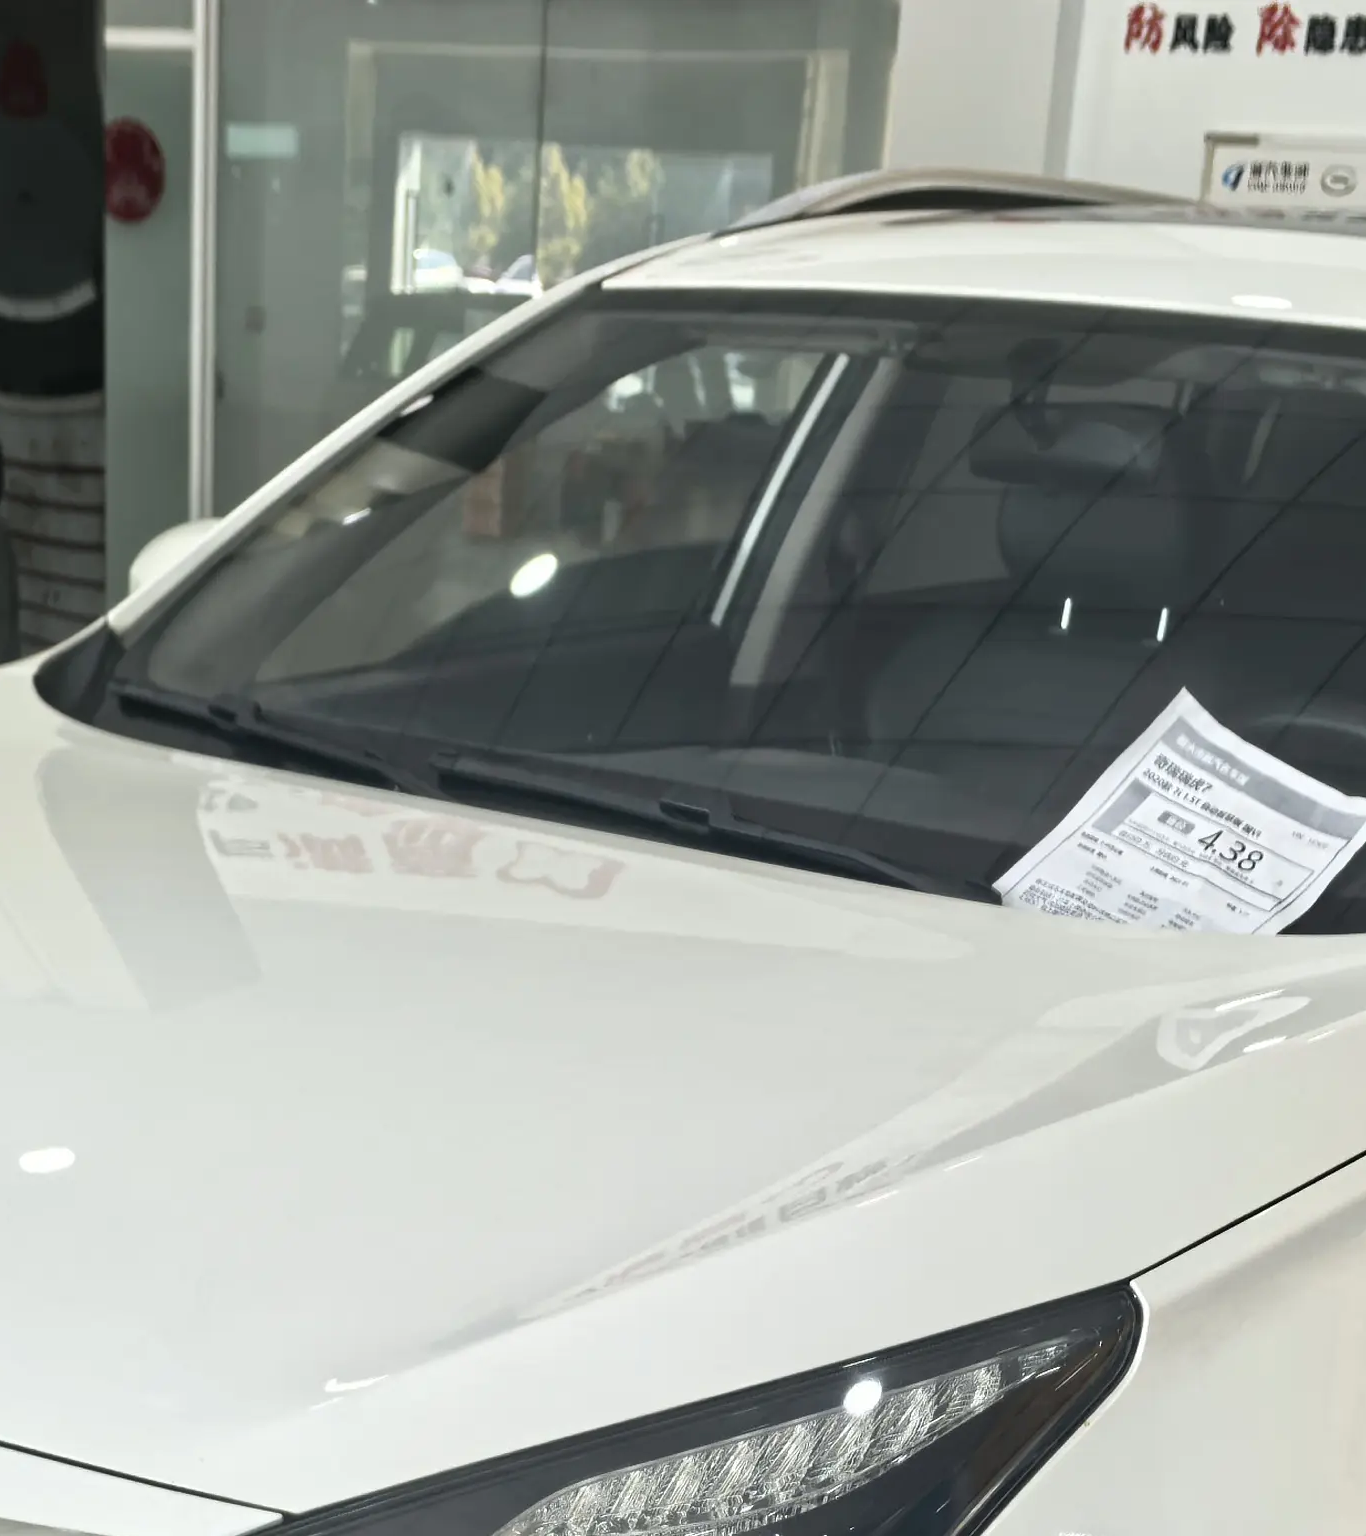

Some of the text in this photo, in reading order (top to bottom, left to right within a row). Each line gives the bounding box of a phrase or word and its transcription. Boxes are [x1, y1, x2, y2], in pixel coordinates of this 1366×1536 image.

[1123, 2, 1237, 55] 防风险
[1197, 829, 1265, 872] 4.38
